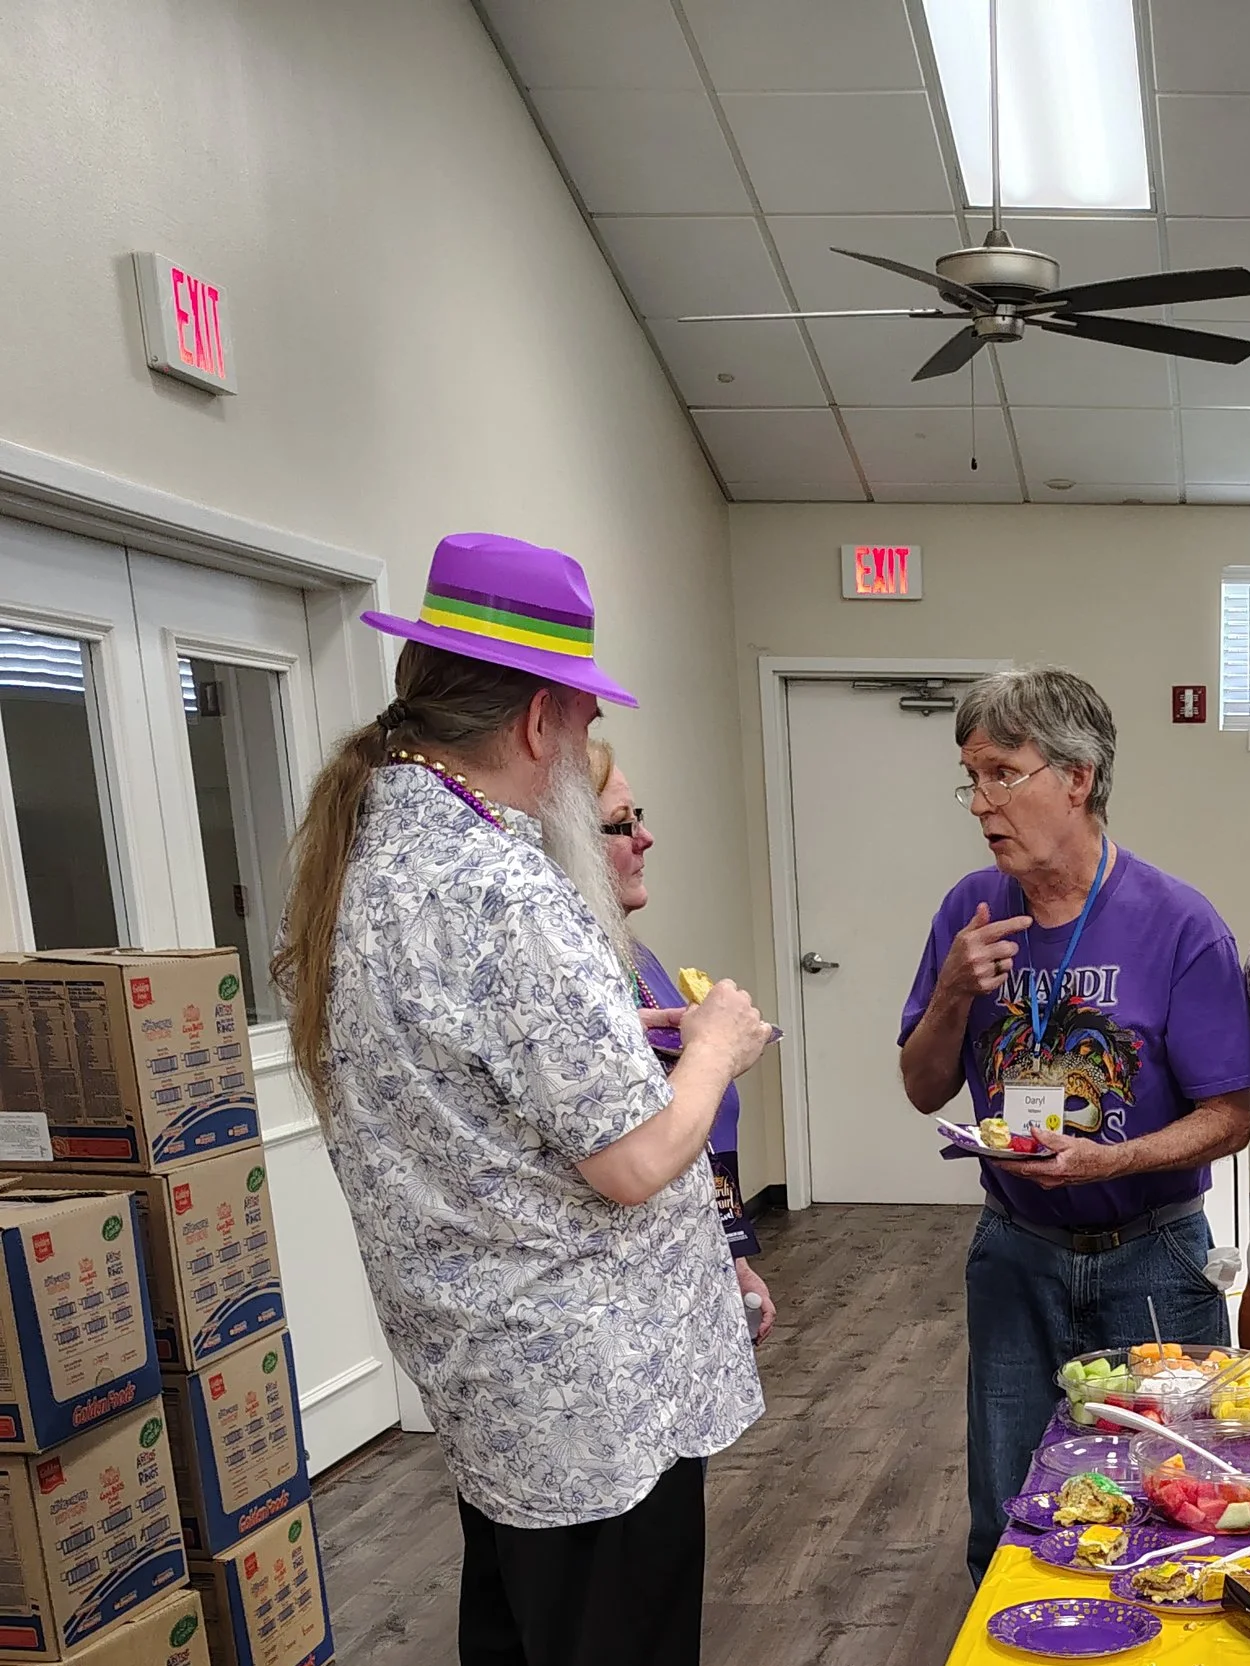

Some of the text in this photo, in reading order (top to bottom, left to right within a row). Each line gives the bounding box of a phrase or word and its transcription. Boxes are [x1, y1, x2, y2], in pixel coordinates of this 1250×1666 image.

[171, 267, 226, 380] EXIT
[854, 546, 911, 595] EXIT
[996, 966, 1120, 1006] MARDI
[1025, 1095, 1046, 1107] Daryl
